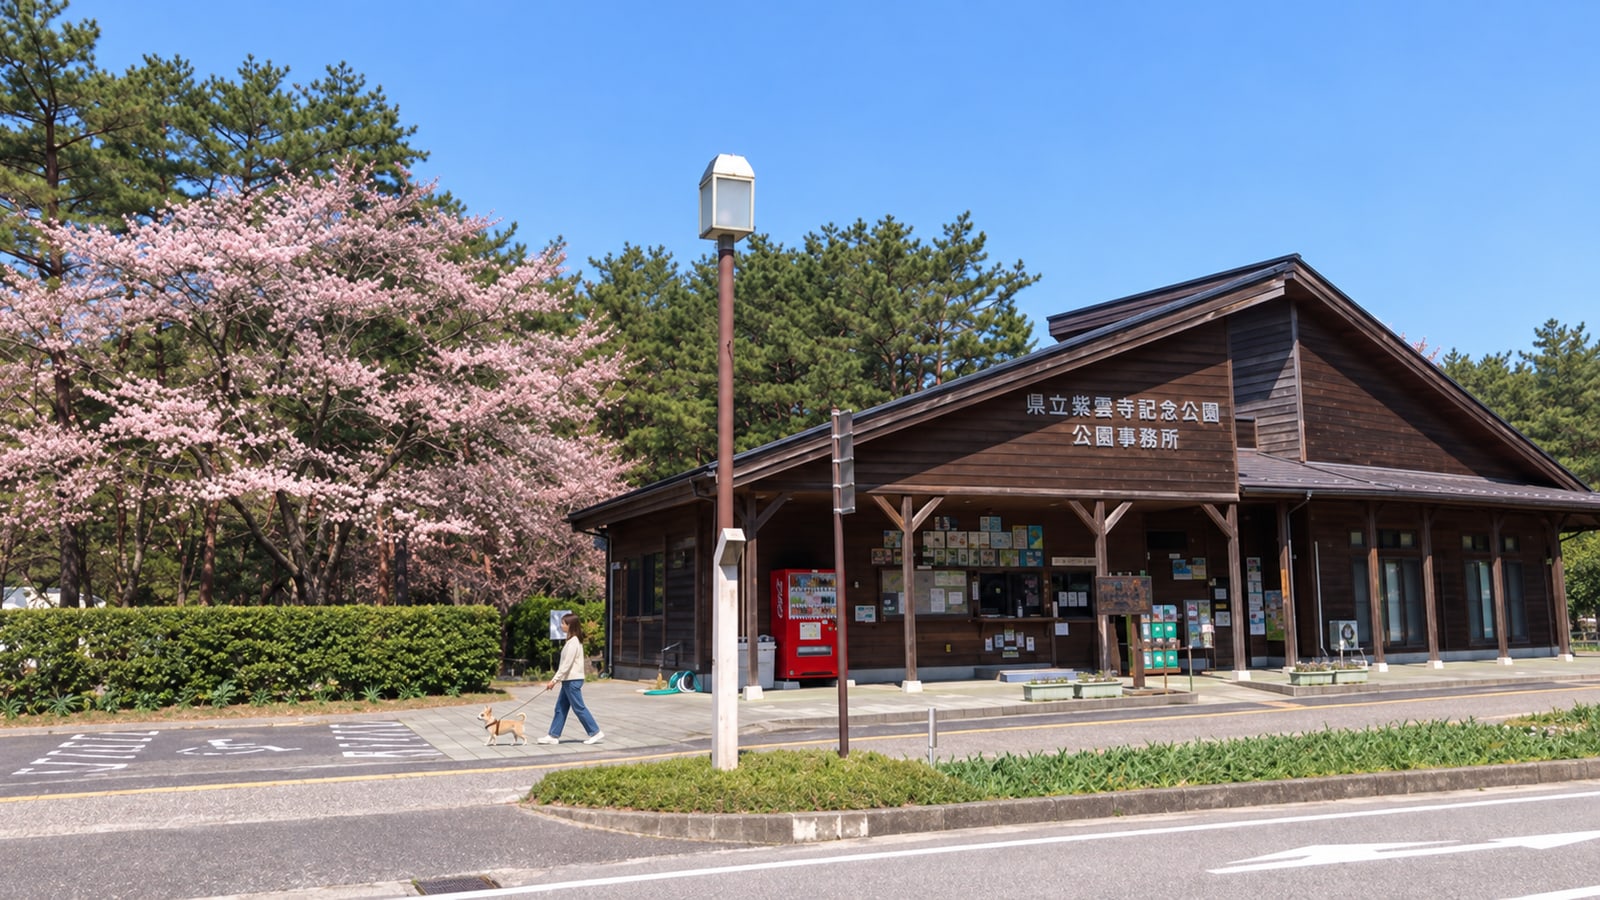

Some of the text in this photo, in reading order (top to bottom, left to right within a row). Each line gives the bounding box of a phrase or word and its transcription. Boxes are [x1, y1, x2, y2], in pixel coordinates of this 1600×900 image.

[1026, 393, 1220, 422] 県立紫雲寺記念公園
[1072, 424, 1179, 449] 公園事務所
